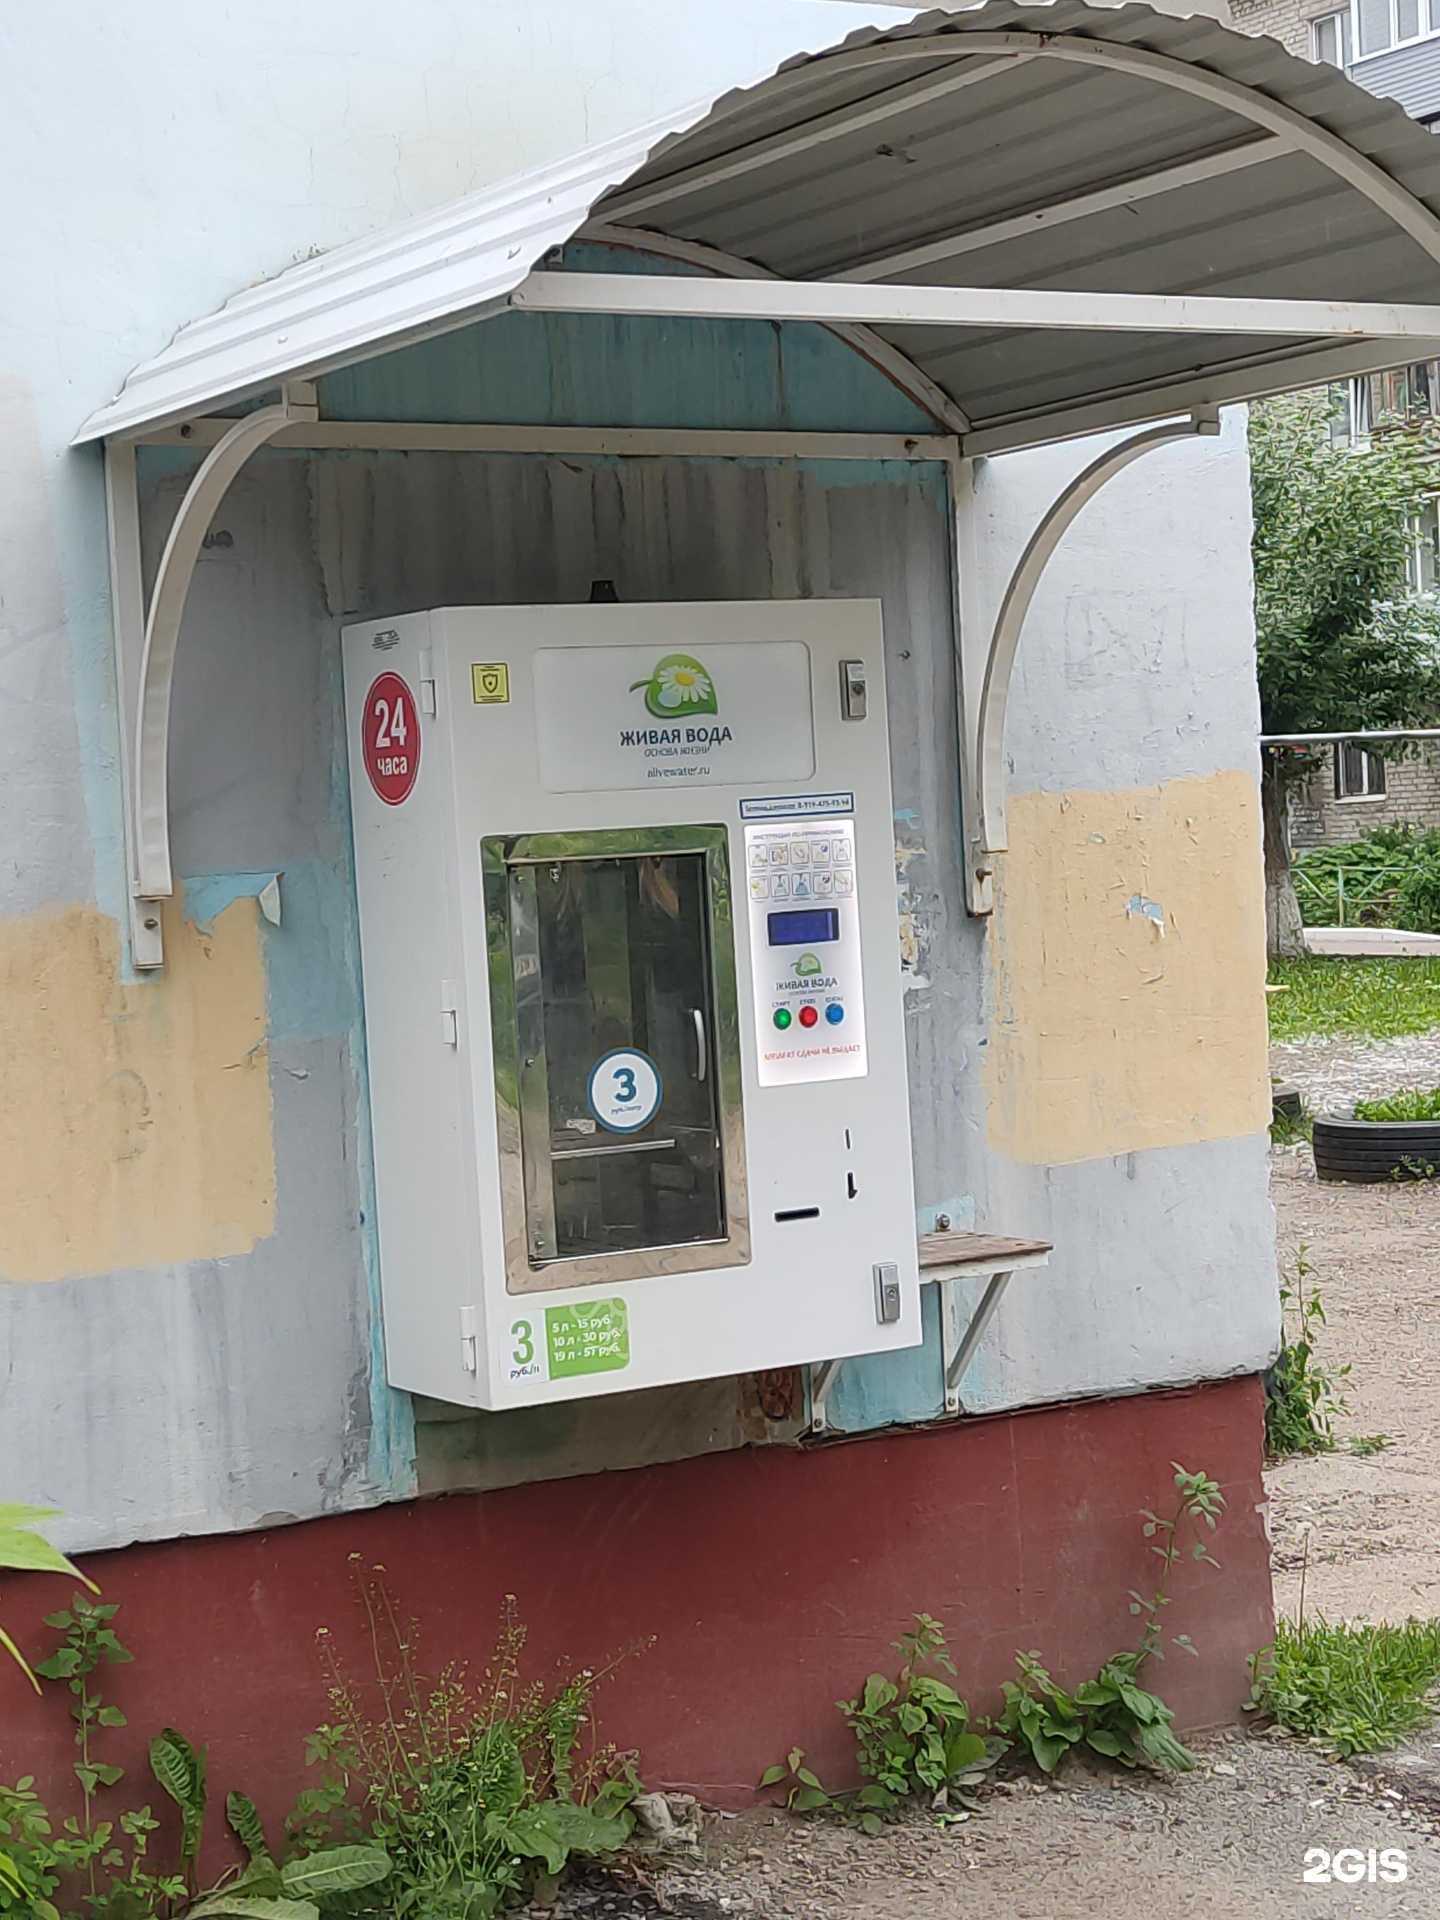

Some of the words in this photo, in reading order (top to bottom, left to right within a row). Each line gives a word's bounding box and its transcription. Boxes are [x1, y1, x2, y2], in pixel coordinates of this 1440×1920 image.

[375, 697, 407, 748] 24
[620, 729, 681, 746] ЖИВАЯ
[686, 726, 733, 746] ВОДА
[377, 756, 408, 776] часа
[613, 1067, 637, 1103] 3
[552, 1322, 559, 1333] 5
[561, 1322, 569, 1332] л
[577, 1318, 588, 1329] 15
[510, 1320, 534, 1365] 3
[553, 1336, 564, 1347] 10
[566, 1336, 575, 1346] л
[582, 1331, 596, 1342] 30
[554, 1351, 565, 1362] 19
[568, 1351, 575, 1360] л
